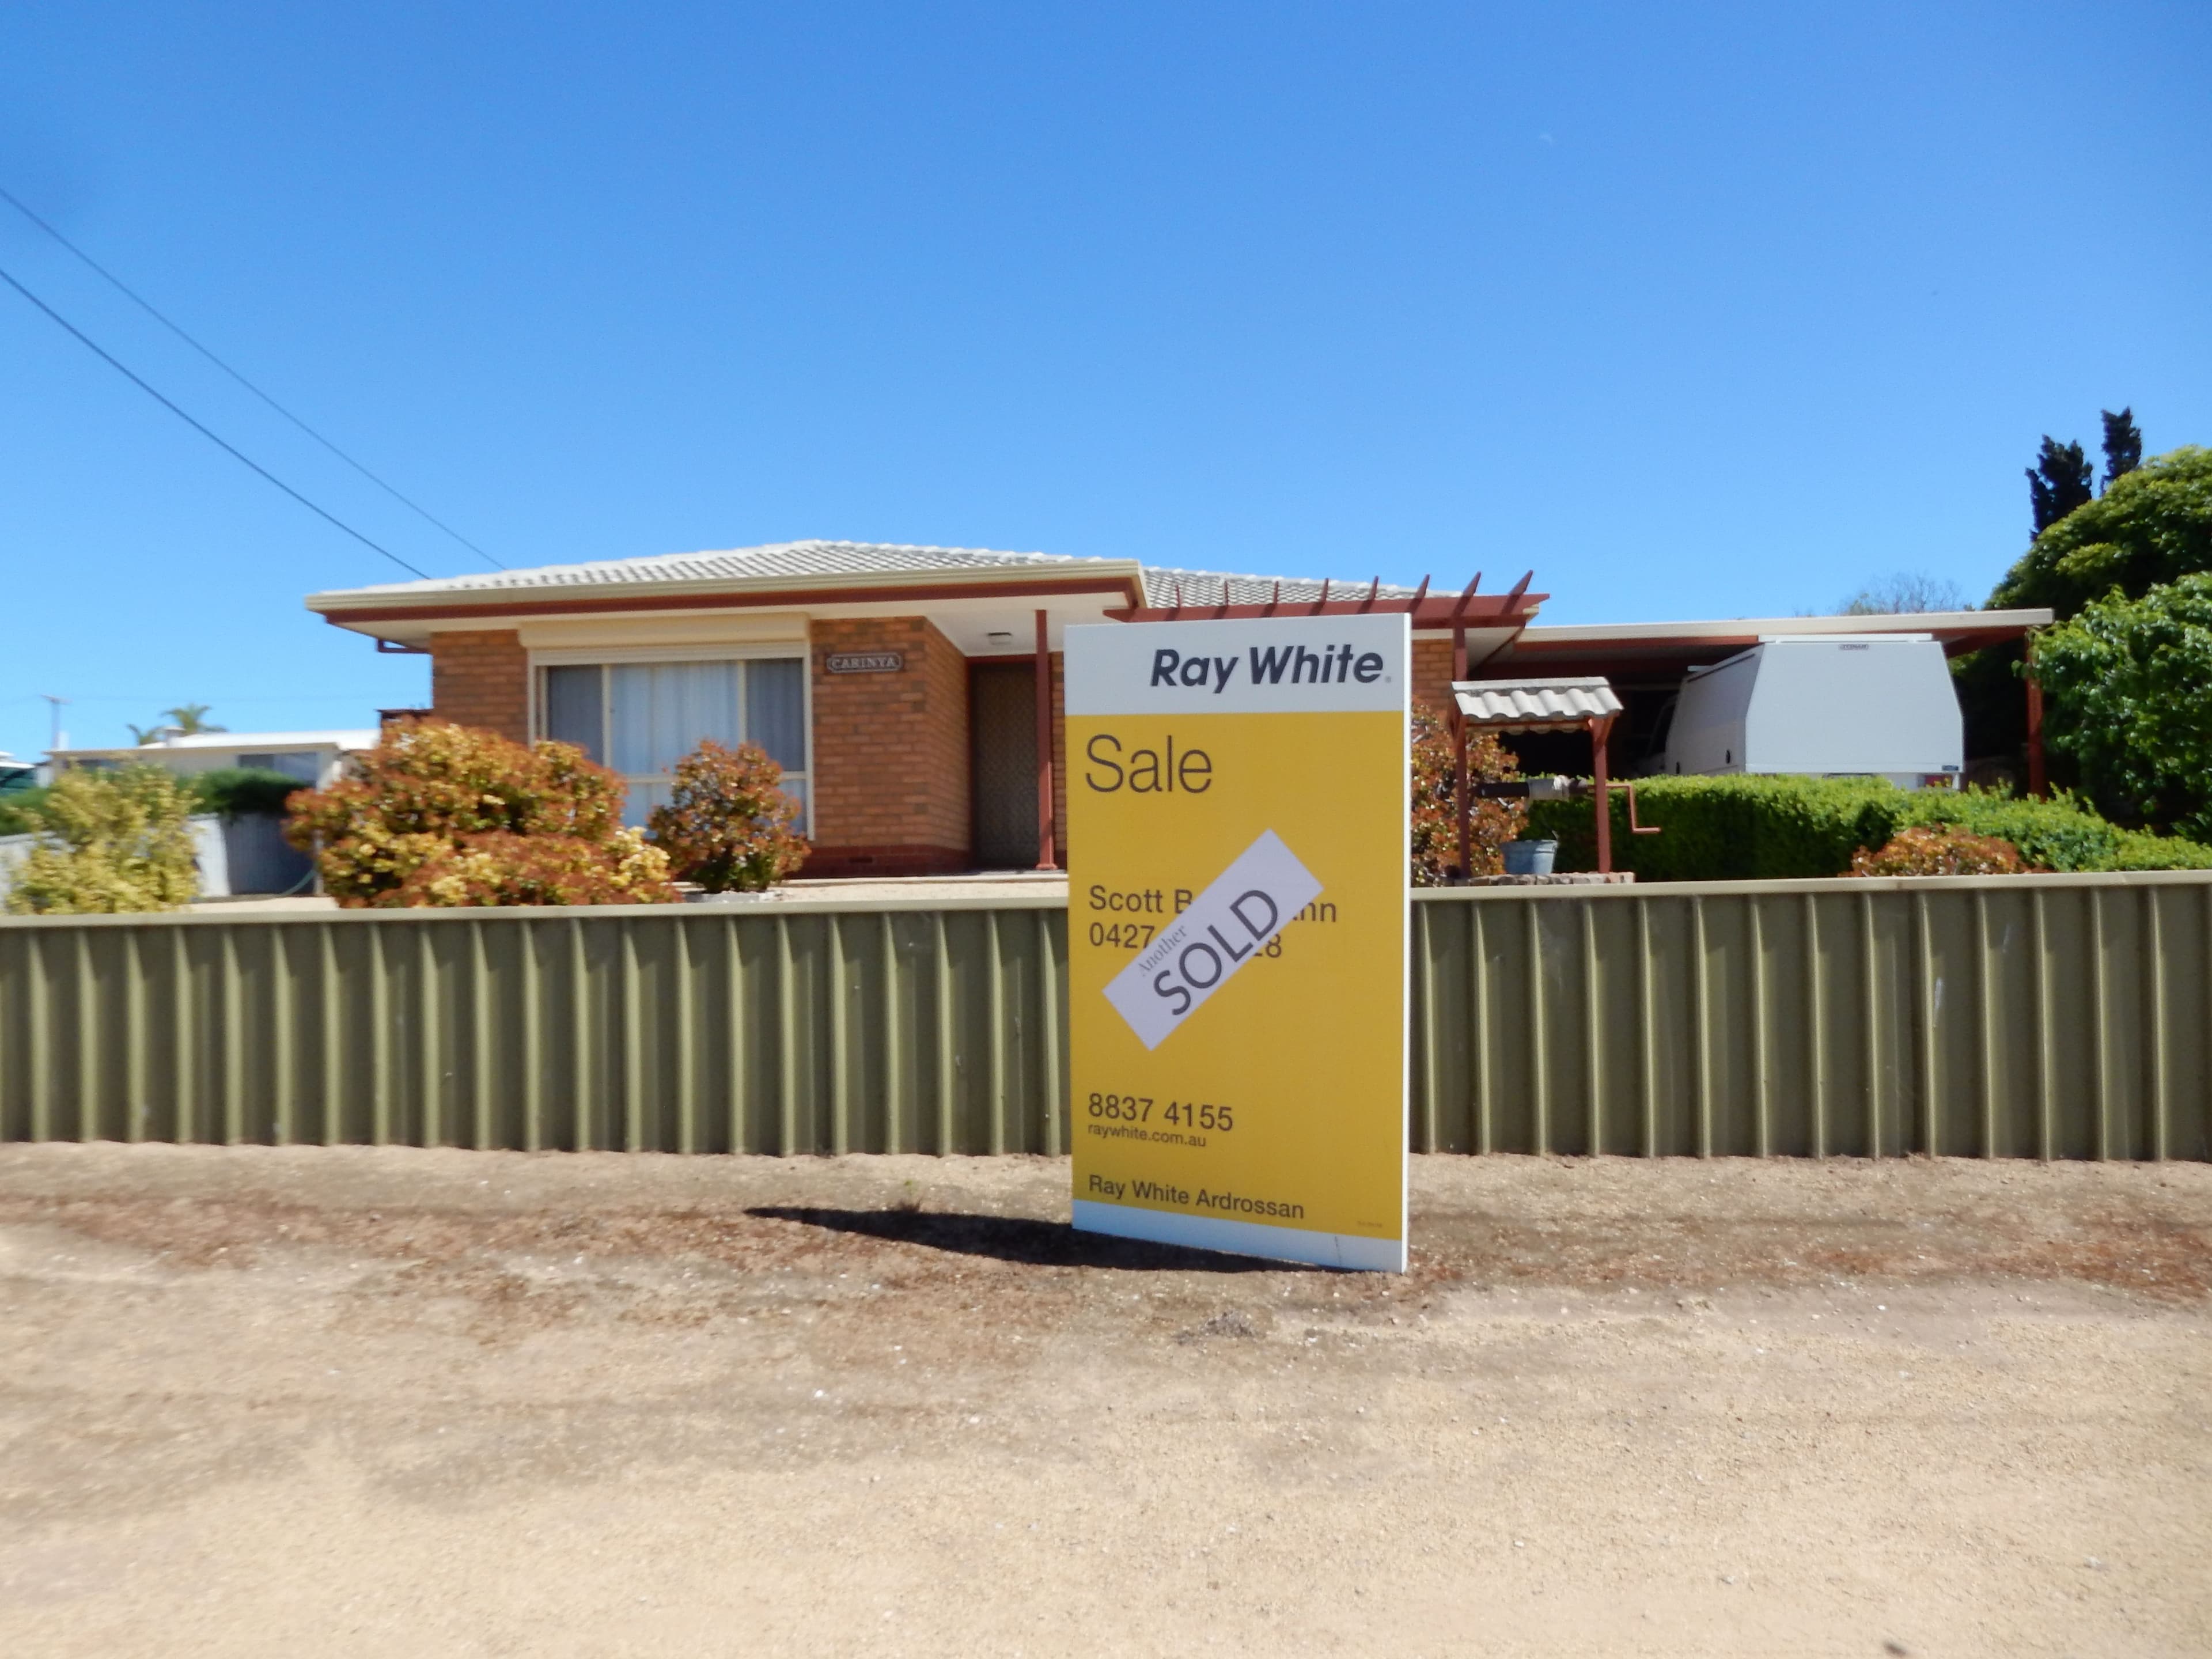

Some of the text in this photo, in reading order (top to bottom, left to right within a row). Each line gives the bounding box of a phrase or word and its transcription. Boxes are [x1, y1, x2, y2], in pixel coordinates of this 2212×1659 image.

[1150, 644, 1384, 694] Ray White
[1085, 733, 1213, 794] Sale
[1089, 884, 1164, 914] Scott
[1089, 922, 1156, 949] 0427
[1138, 925, 1187, 978] Another
[1153, 889, 1278, 1016] SOLD
[1088, 1092, 1233, 1132] 8837 4155
[1088, 1123, 1206, 1147] raywhite.com.au
[1089, 1173, 1305, 1220] Ray White Ardrossan
